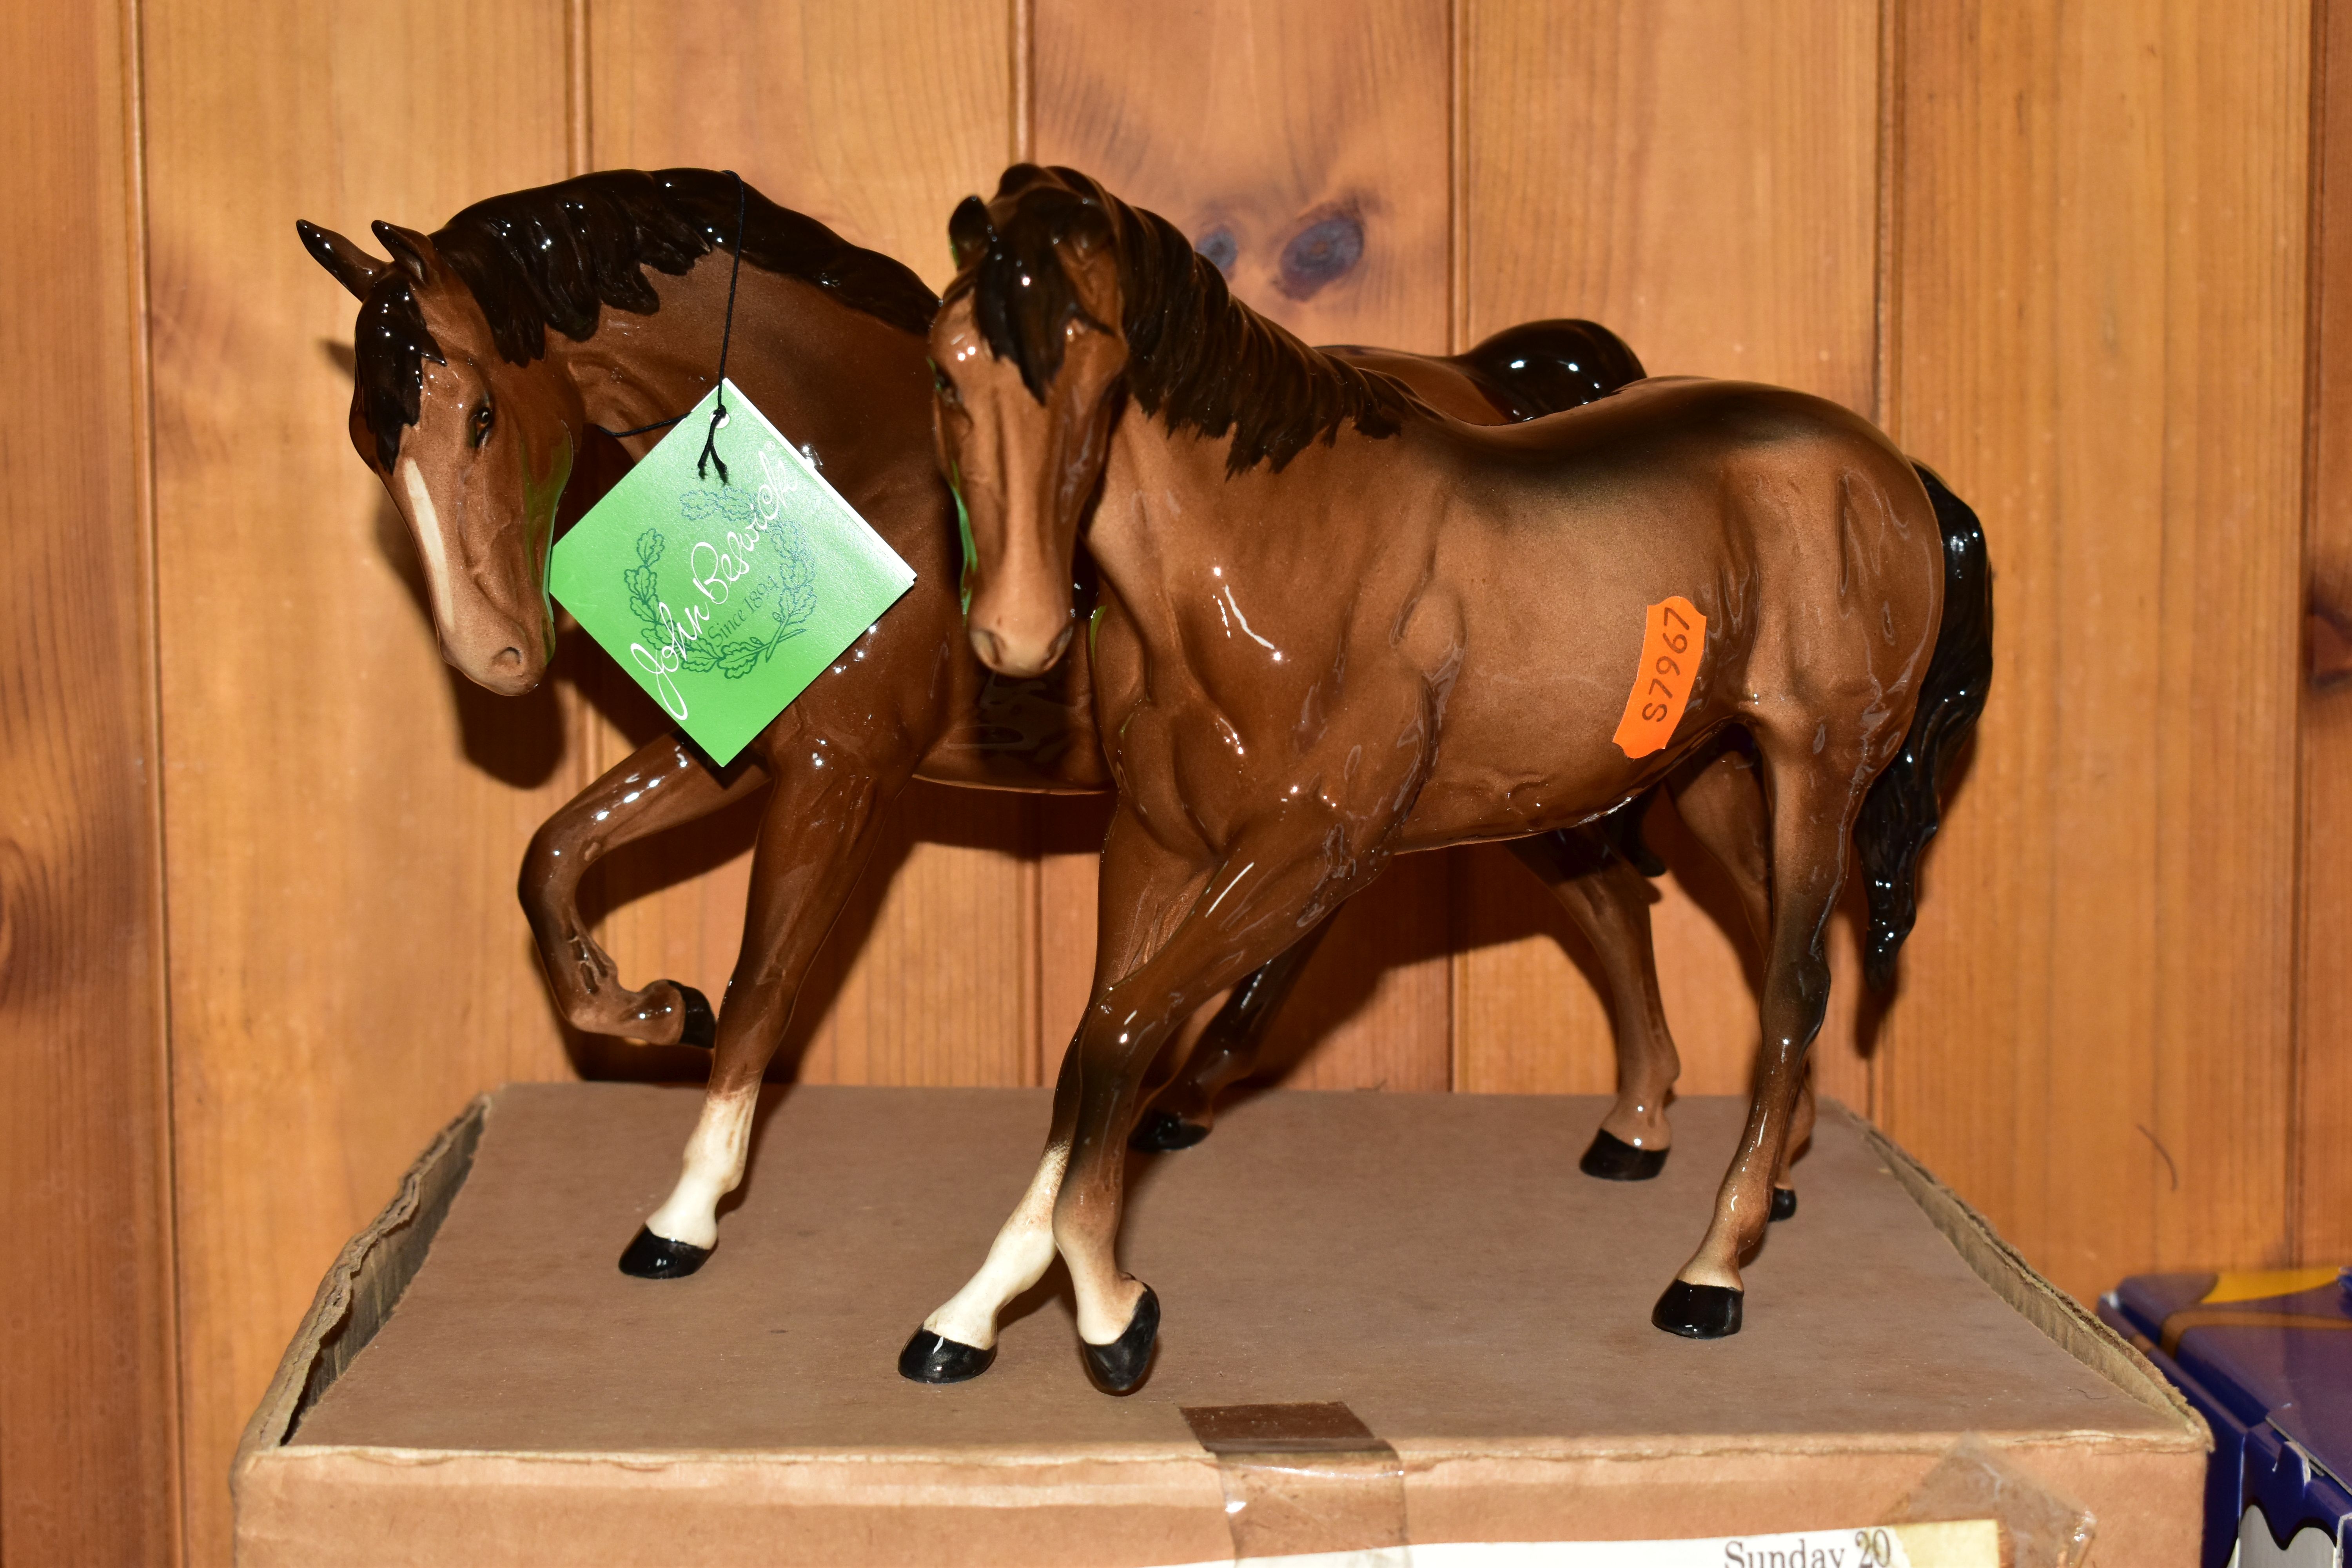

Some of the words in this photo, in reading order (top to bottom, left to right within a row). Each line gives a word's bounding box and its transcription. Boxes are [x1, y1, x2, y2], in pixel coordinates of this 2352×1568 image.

[630, 601, 710, 720] John
[708, 609, 747, 647] Since
[742, 575, 779, 614] 1894
[1642, 607, 1690, 722] S7967
